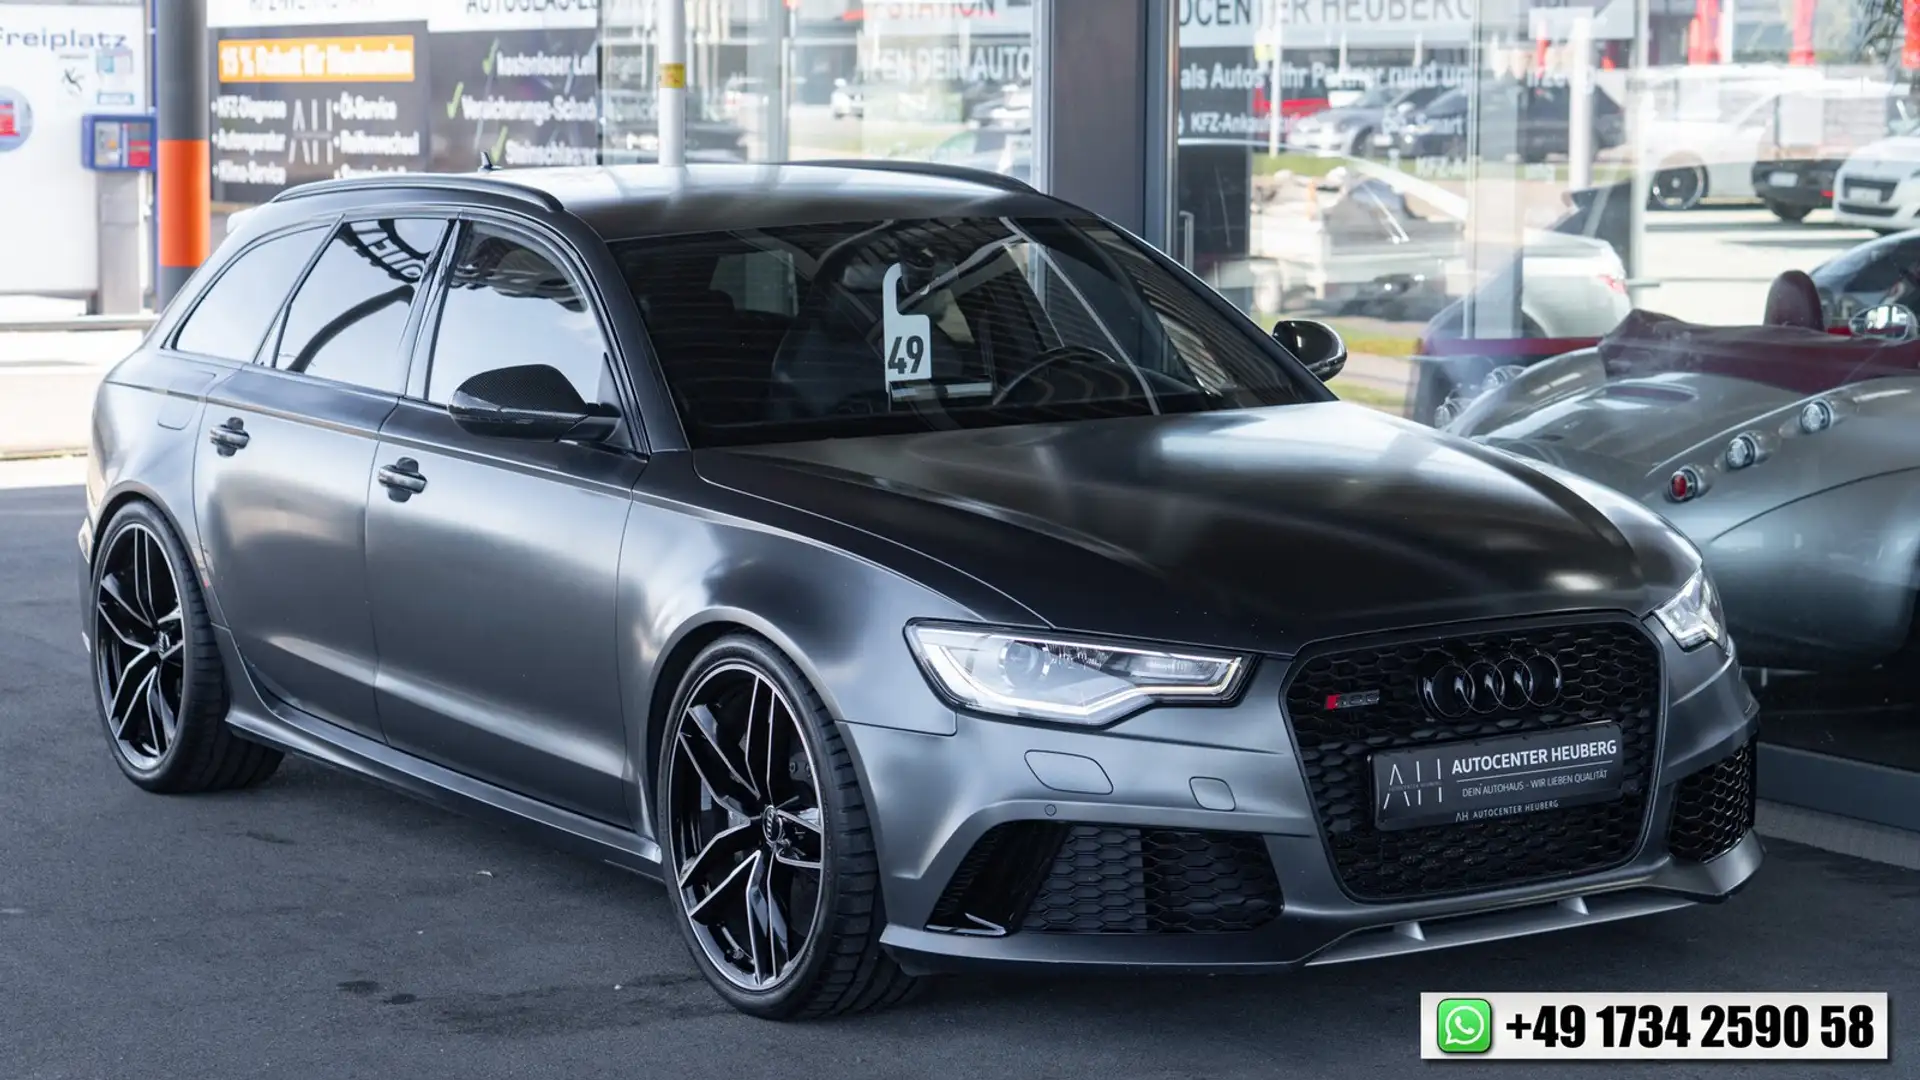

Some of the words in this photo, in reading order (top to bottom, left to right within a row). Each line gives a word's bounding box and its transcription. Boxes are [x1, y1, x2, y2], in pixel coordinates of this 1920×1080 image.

[973, 47, 1032, 80] AUTO
[887, 335, 925, 375] 49
[1452, 749, 1549, 775] AUTOCENTER
[1551, 740, 1617, 763] HEUBERG
[1462, 786, 1482, 798] DEIN
[1482, 782, 1525, 796] AUTOHAUS
[1530, 778, 1546, 790] WIR
[1547, 775, 1573, 788] LIEBEN
[1574, 769, 1608, 786] QUALITÄT
[1473, 805, 1523, 819] AUTOCENTER
[1525, 800, 1559, 812] HEUBERG
